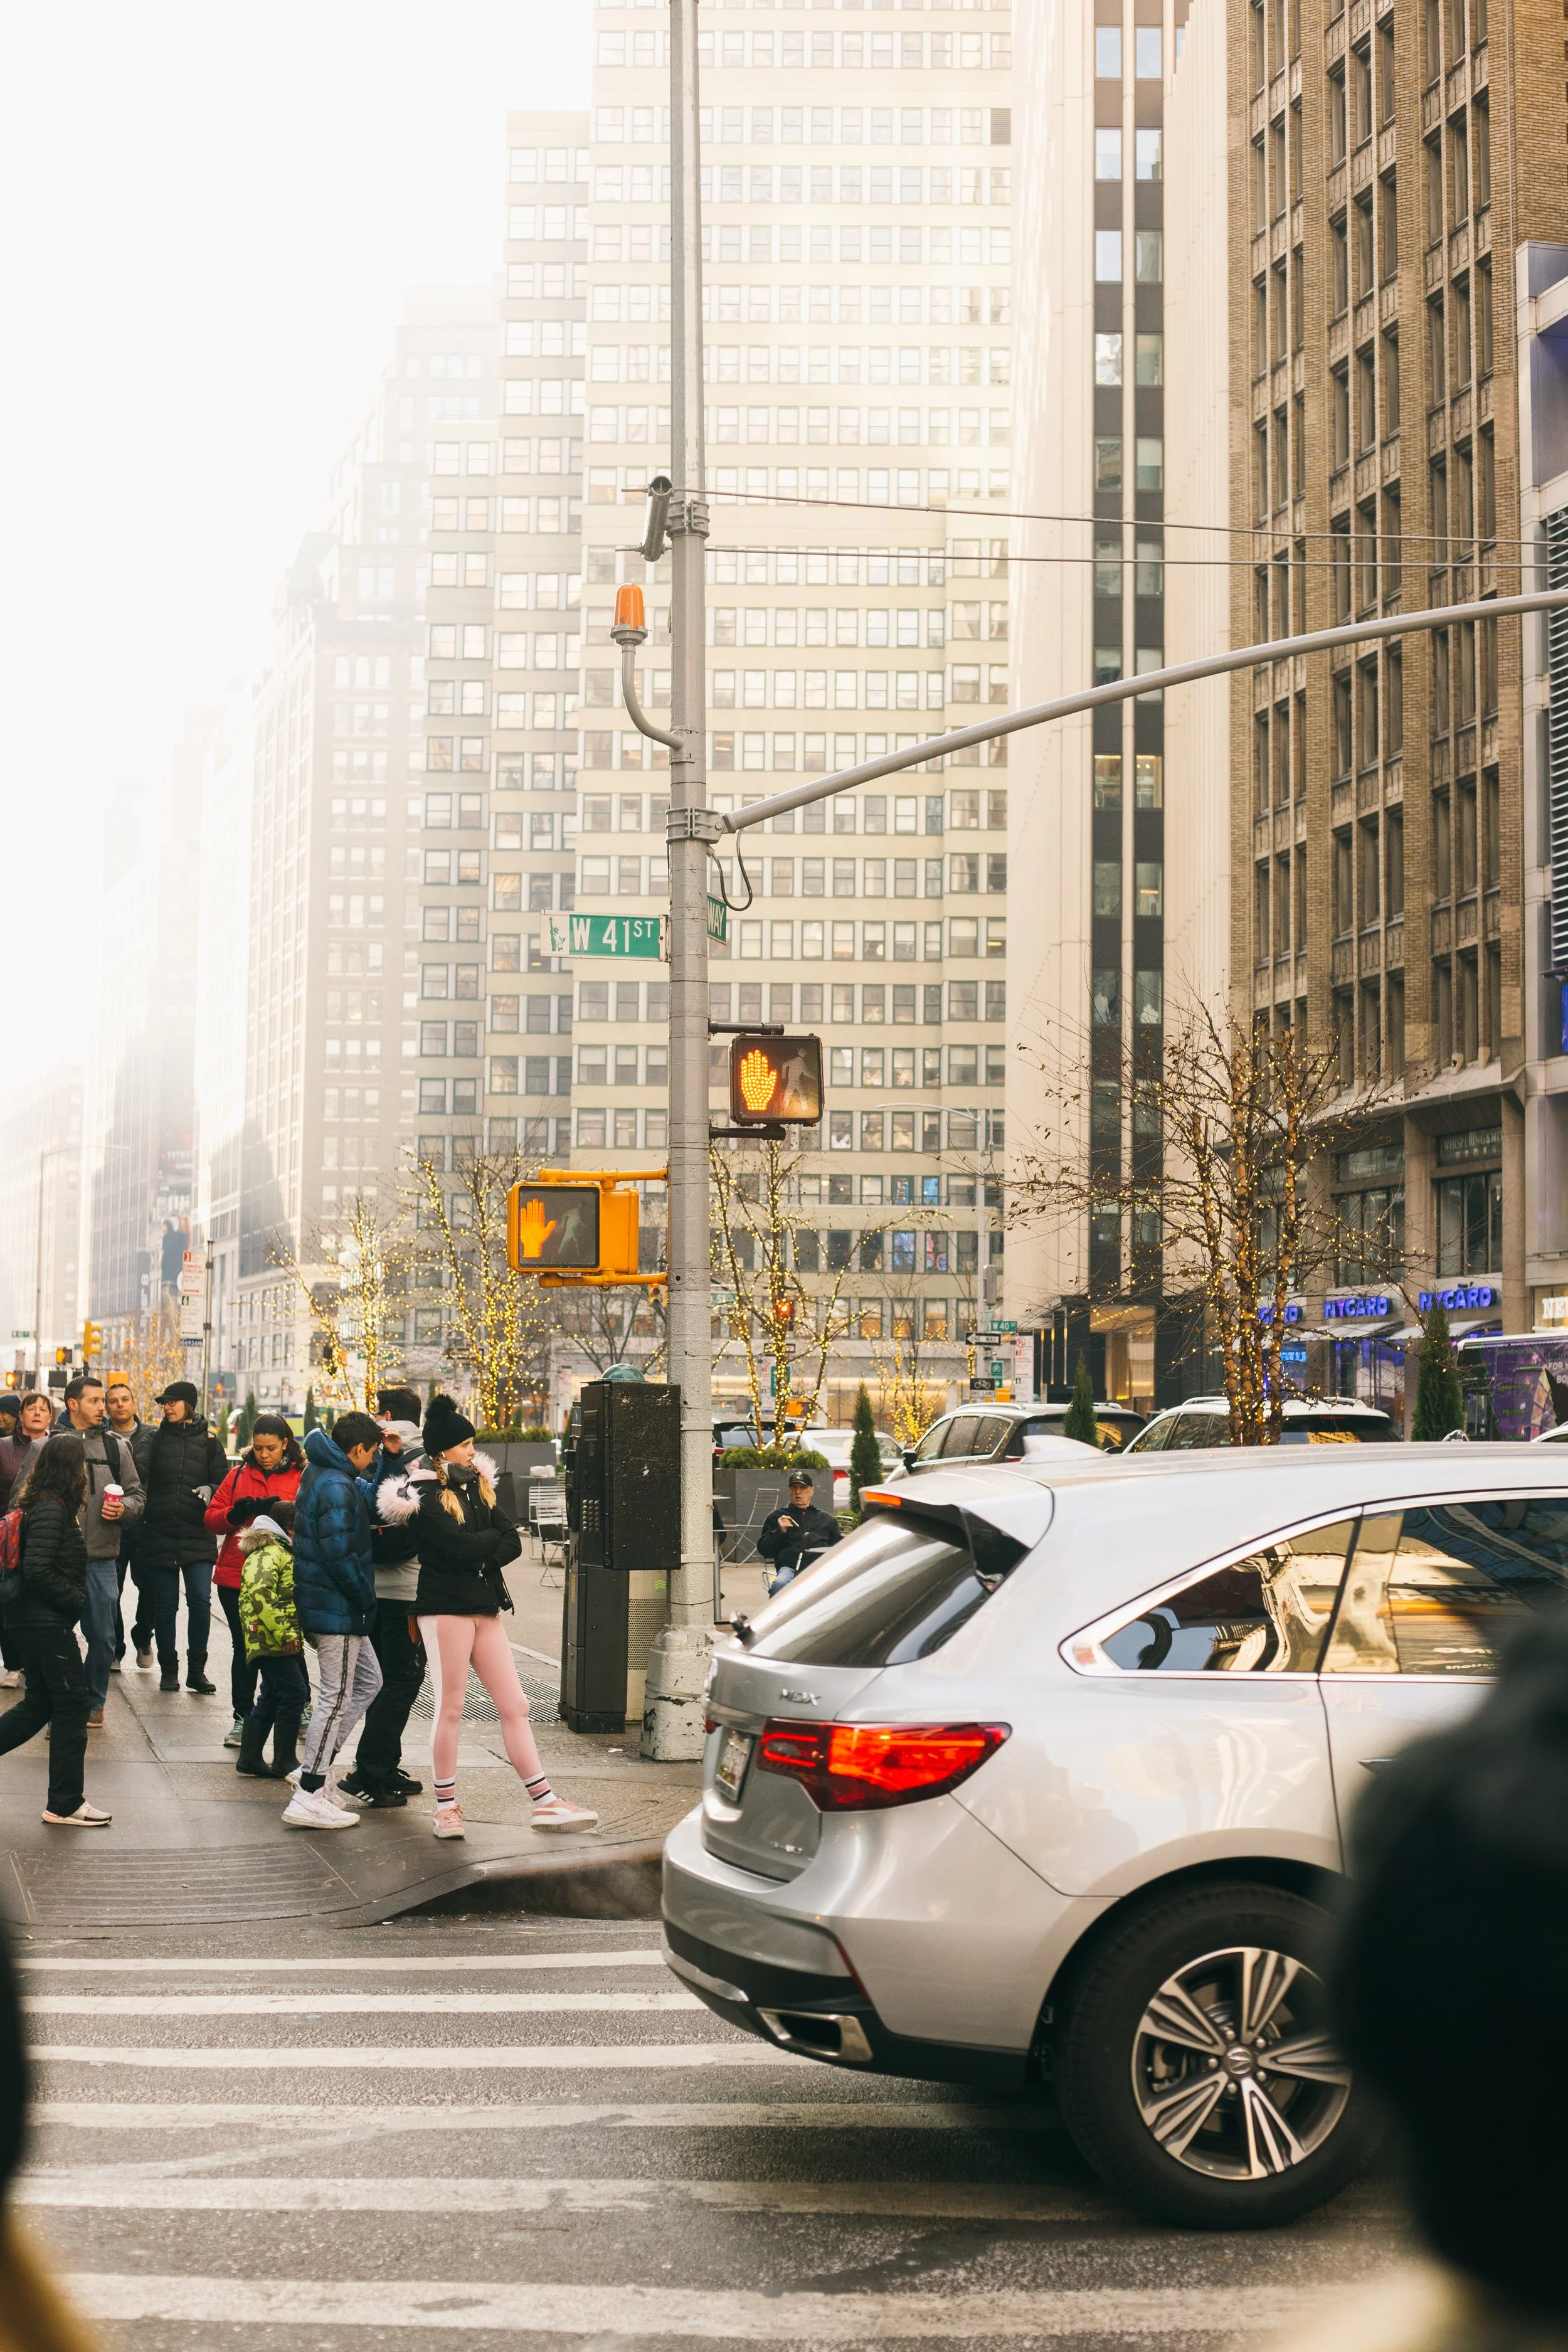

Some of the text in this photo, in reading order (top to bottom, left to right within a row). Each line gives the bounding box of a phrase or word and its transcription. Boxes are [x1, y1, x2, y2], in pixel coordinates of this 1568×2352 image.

[573, 918, 654, 953] W 41ST
[1549, 1362, 1563, 1370] FOR
